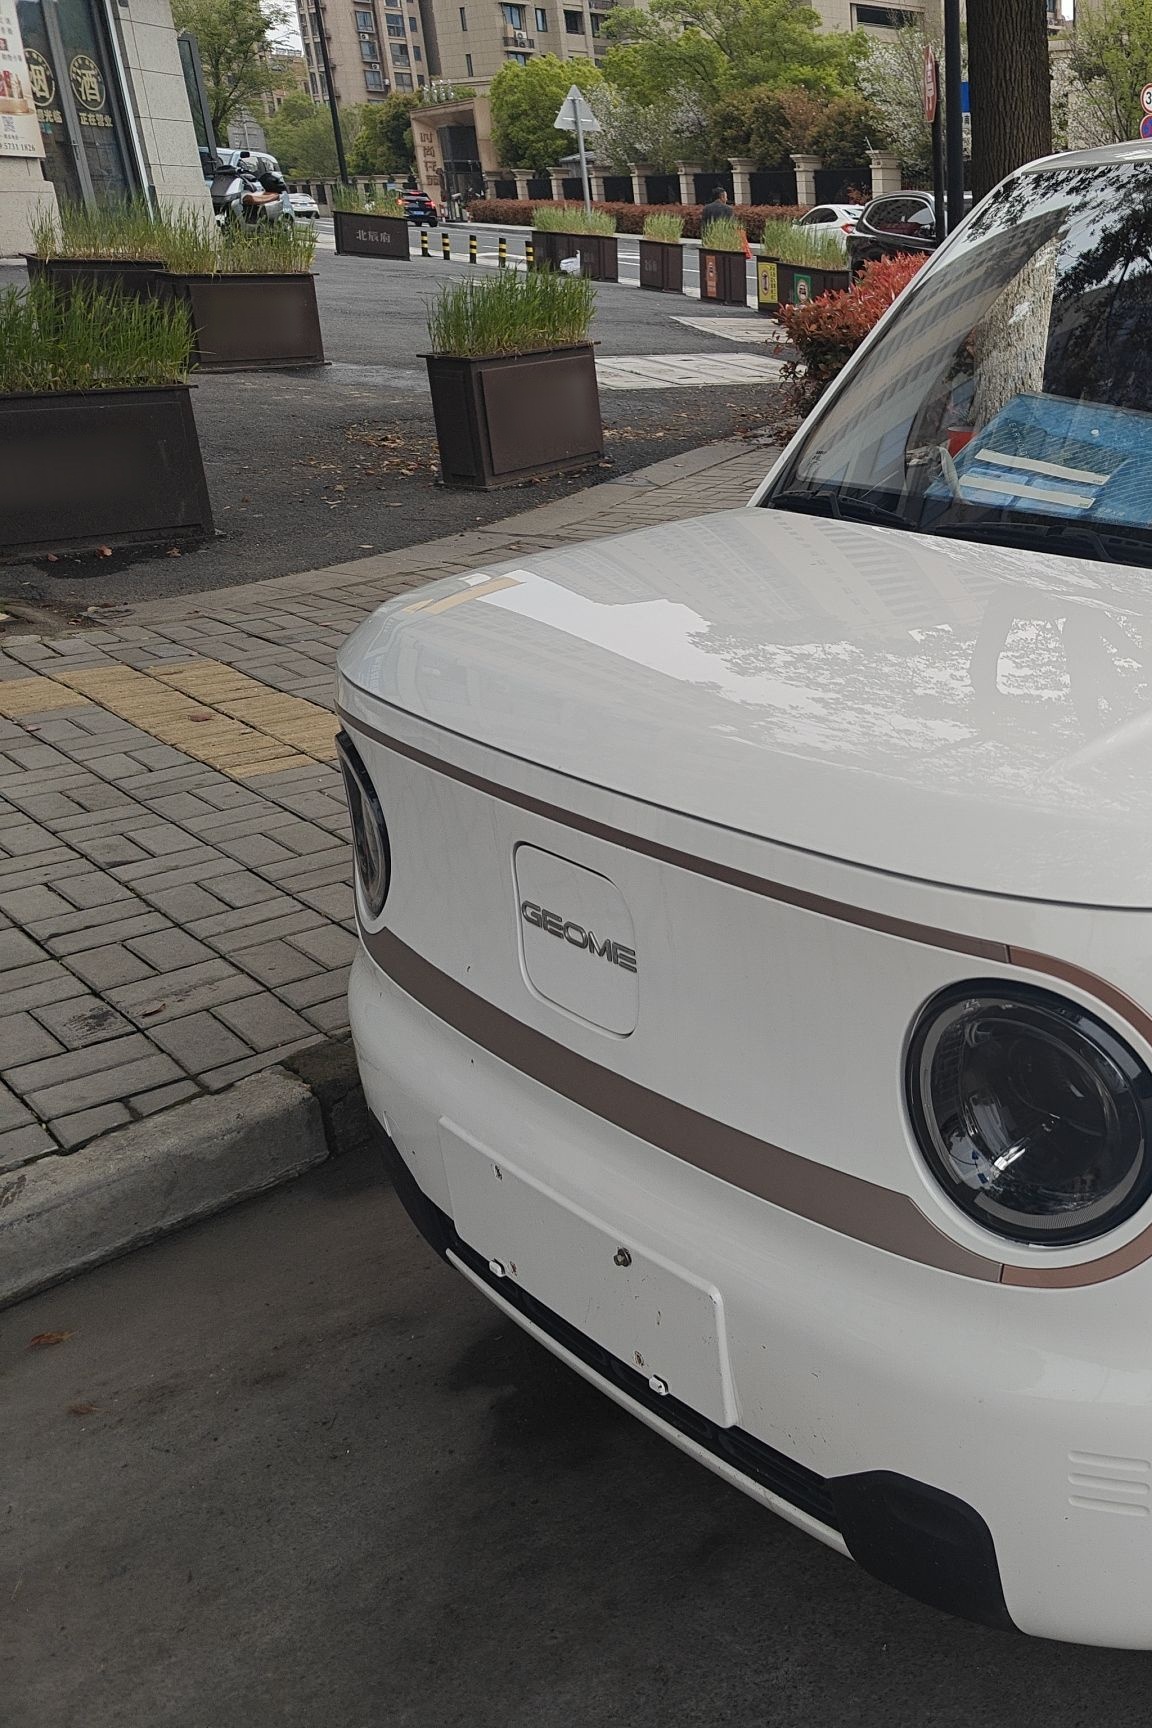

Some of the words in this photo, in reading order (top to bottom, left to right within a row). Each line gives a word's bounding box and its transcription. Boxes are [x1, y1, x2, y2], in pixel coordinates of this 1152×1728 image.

[76, 68, 101, 103] 酒
[79, 112, 114, 127] 正在营业
[521, 900, 638, 974] GEOME
